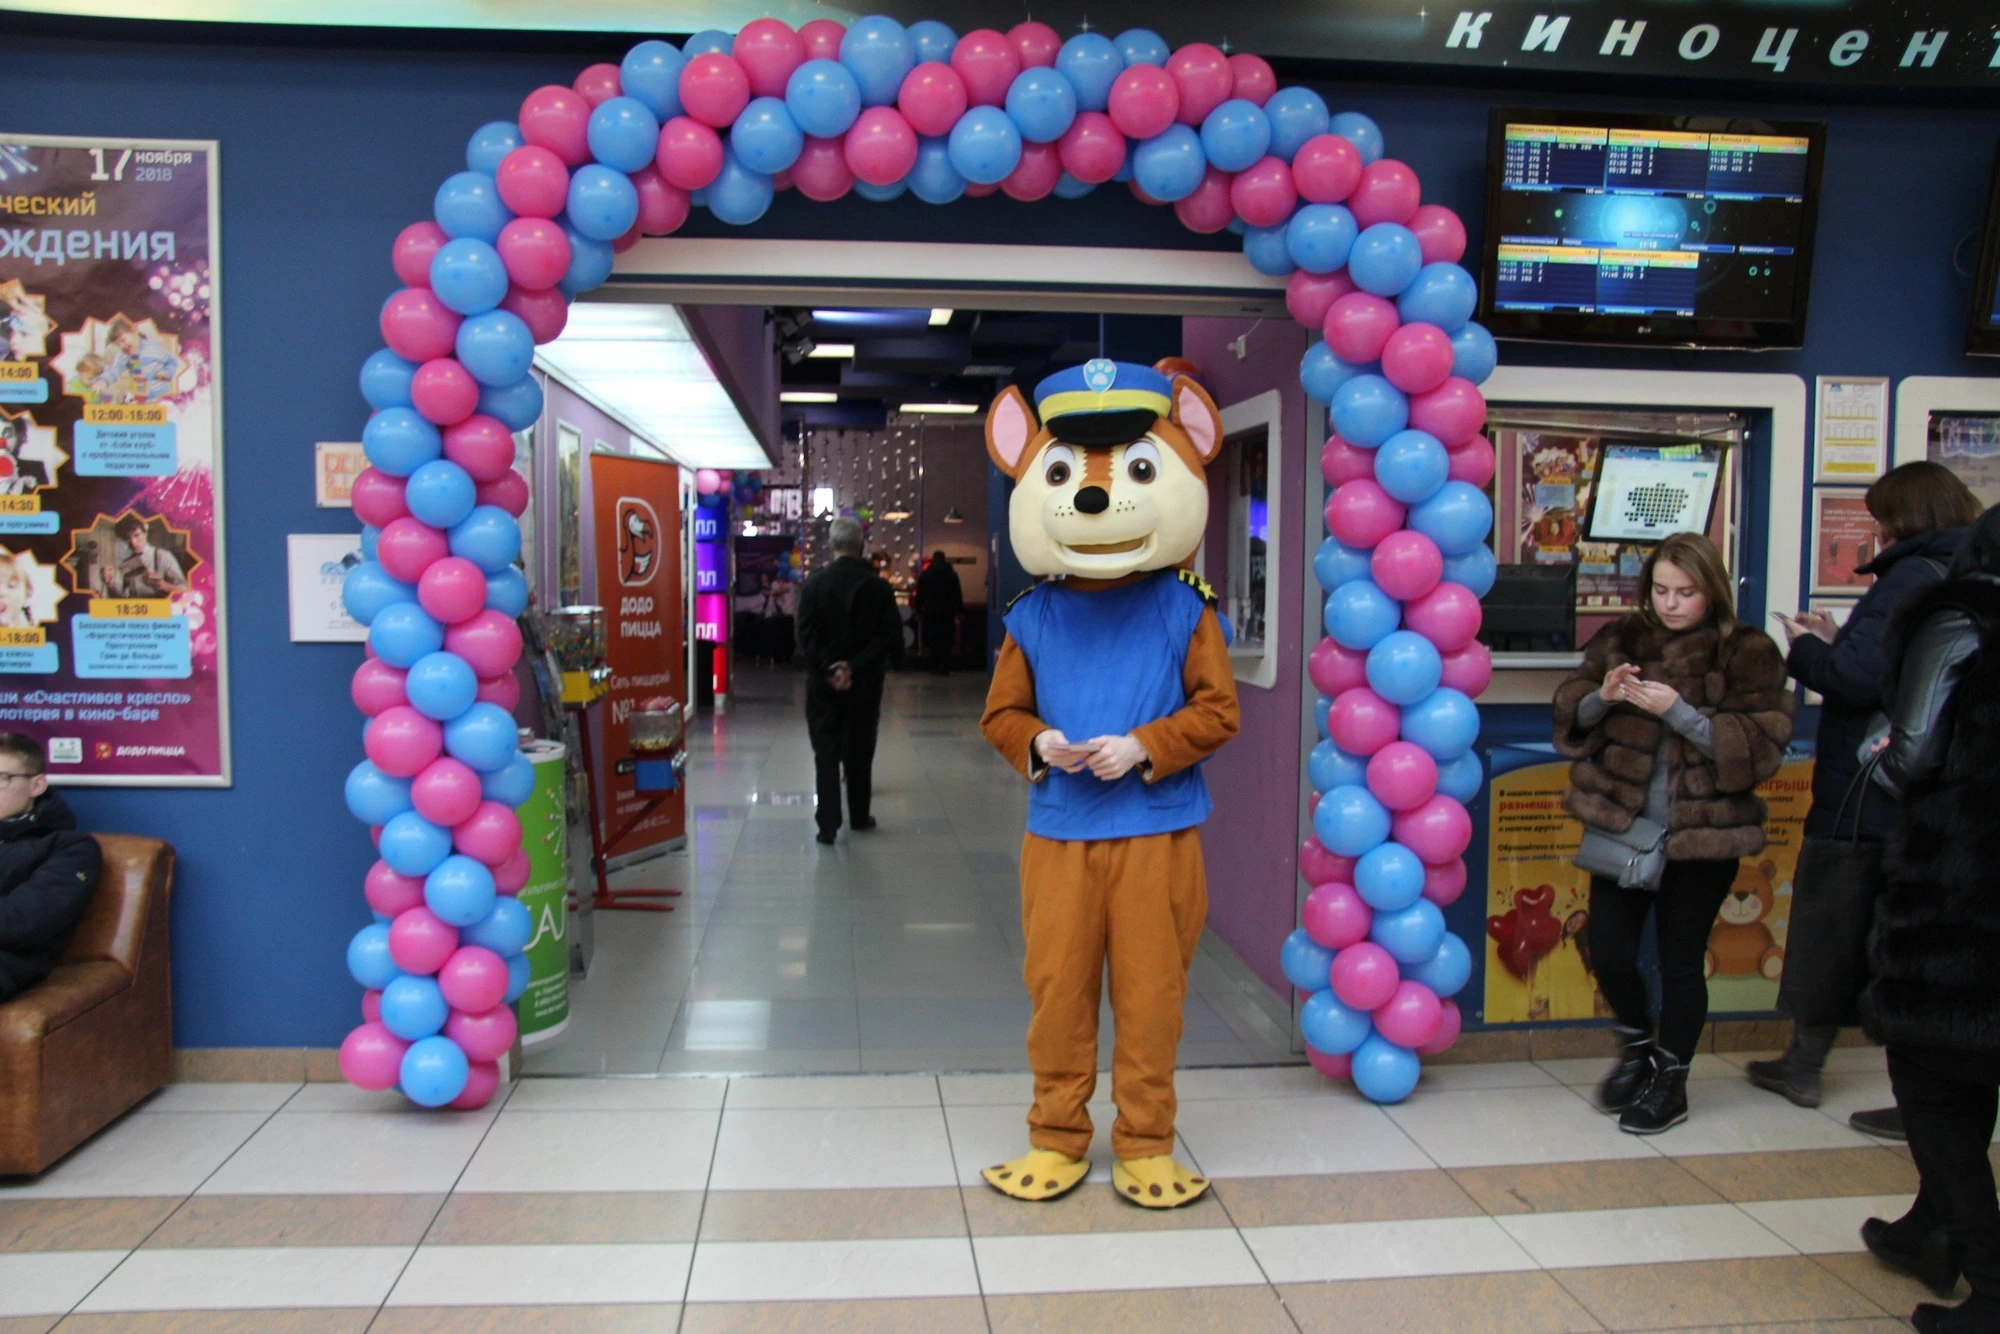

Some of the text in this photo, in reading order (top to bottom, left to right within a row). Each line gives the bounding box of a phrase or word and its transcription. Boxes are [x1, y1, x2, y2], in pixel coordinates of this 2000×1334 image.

[89, 148, 133, 181] 17
[135, 151, 192, 166] ноября
[135, 167, 173, 182] 2018
[0, 191, 96, 216] ческий
[0, 227, 176, 266] ждения
[115, 604, 148, 615] 18:30
[619, 596, 654, 616] ДОДО
[619, 620, 662, 639] ПИЦЦА
[610, 674, 630, 690] Сеть
[23, 689, 123, 704] «Счастливое
[127, 692, 191, 706] кресло»
[64, 708, 74, 720] в
[78, 706, 160, 723] кино-баре
